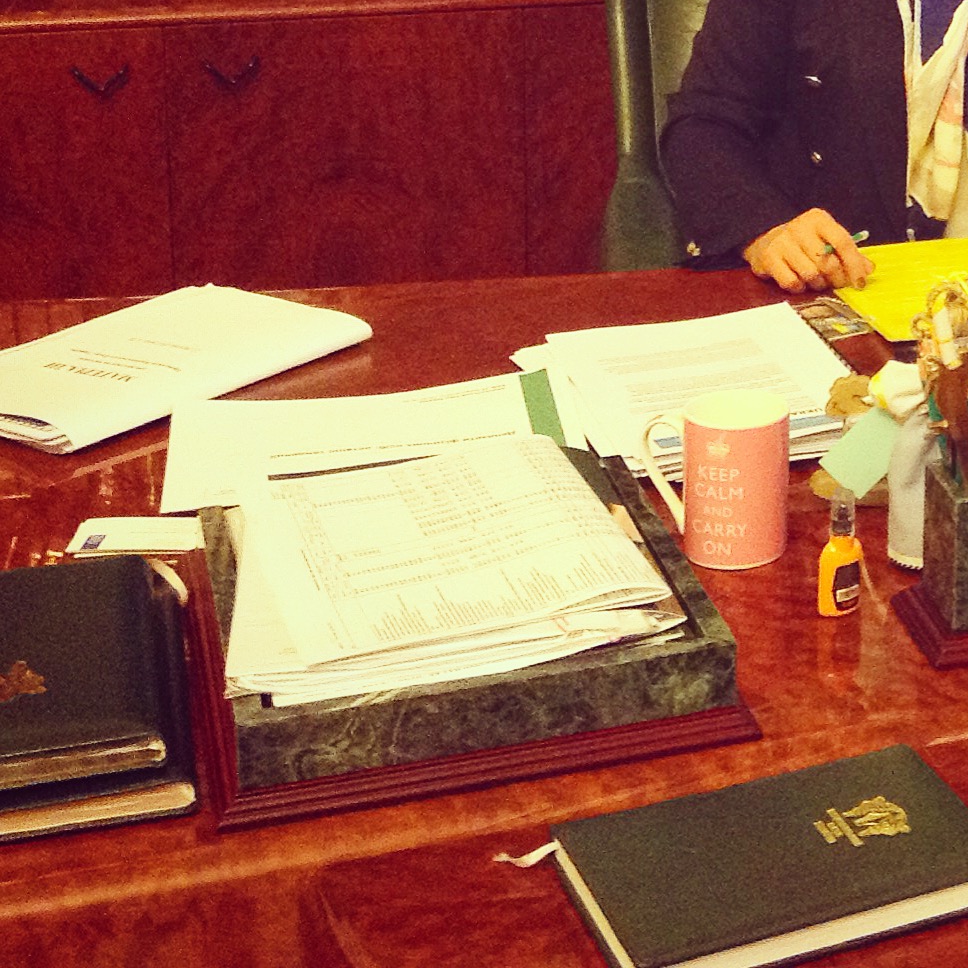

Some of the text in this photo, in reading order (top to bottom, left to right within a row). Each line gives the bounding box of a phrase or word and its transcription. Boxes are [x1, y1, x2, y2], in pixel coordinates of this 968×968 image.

[698, 464, 740, 482] KEEP
[695, 482, 744, 500] CALM
[703, 506, 733, 517] AND
[692, 519, 747, 537] CARRY
[703, 540, 732, 556] ON
